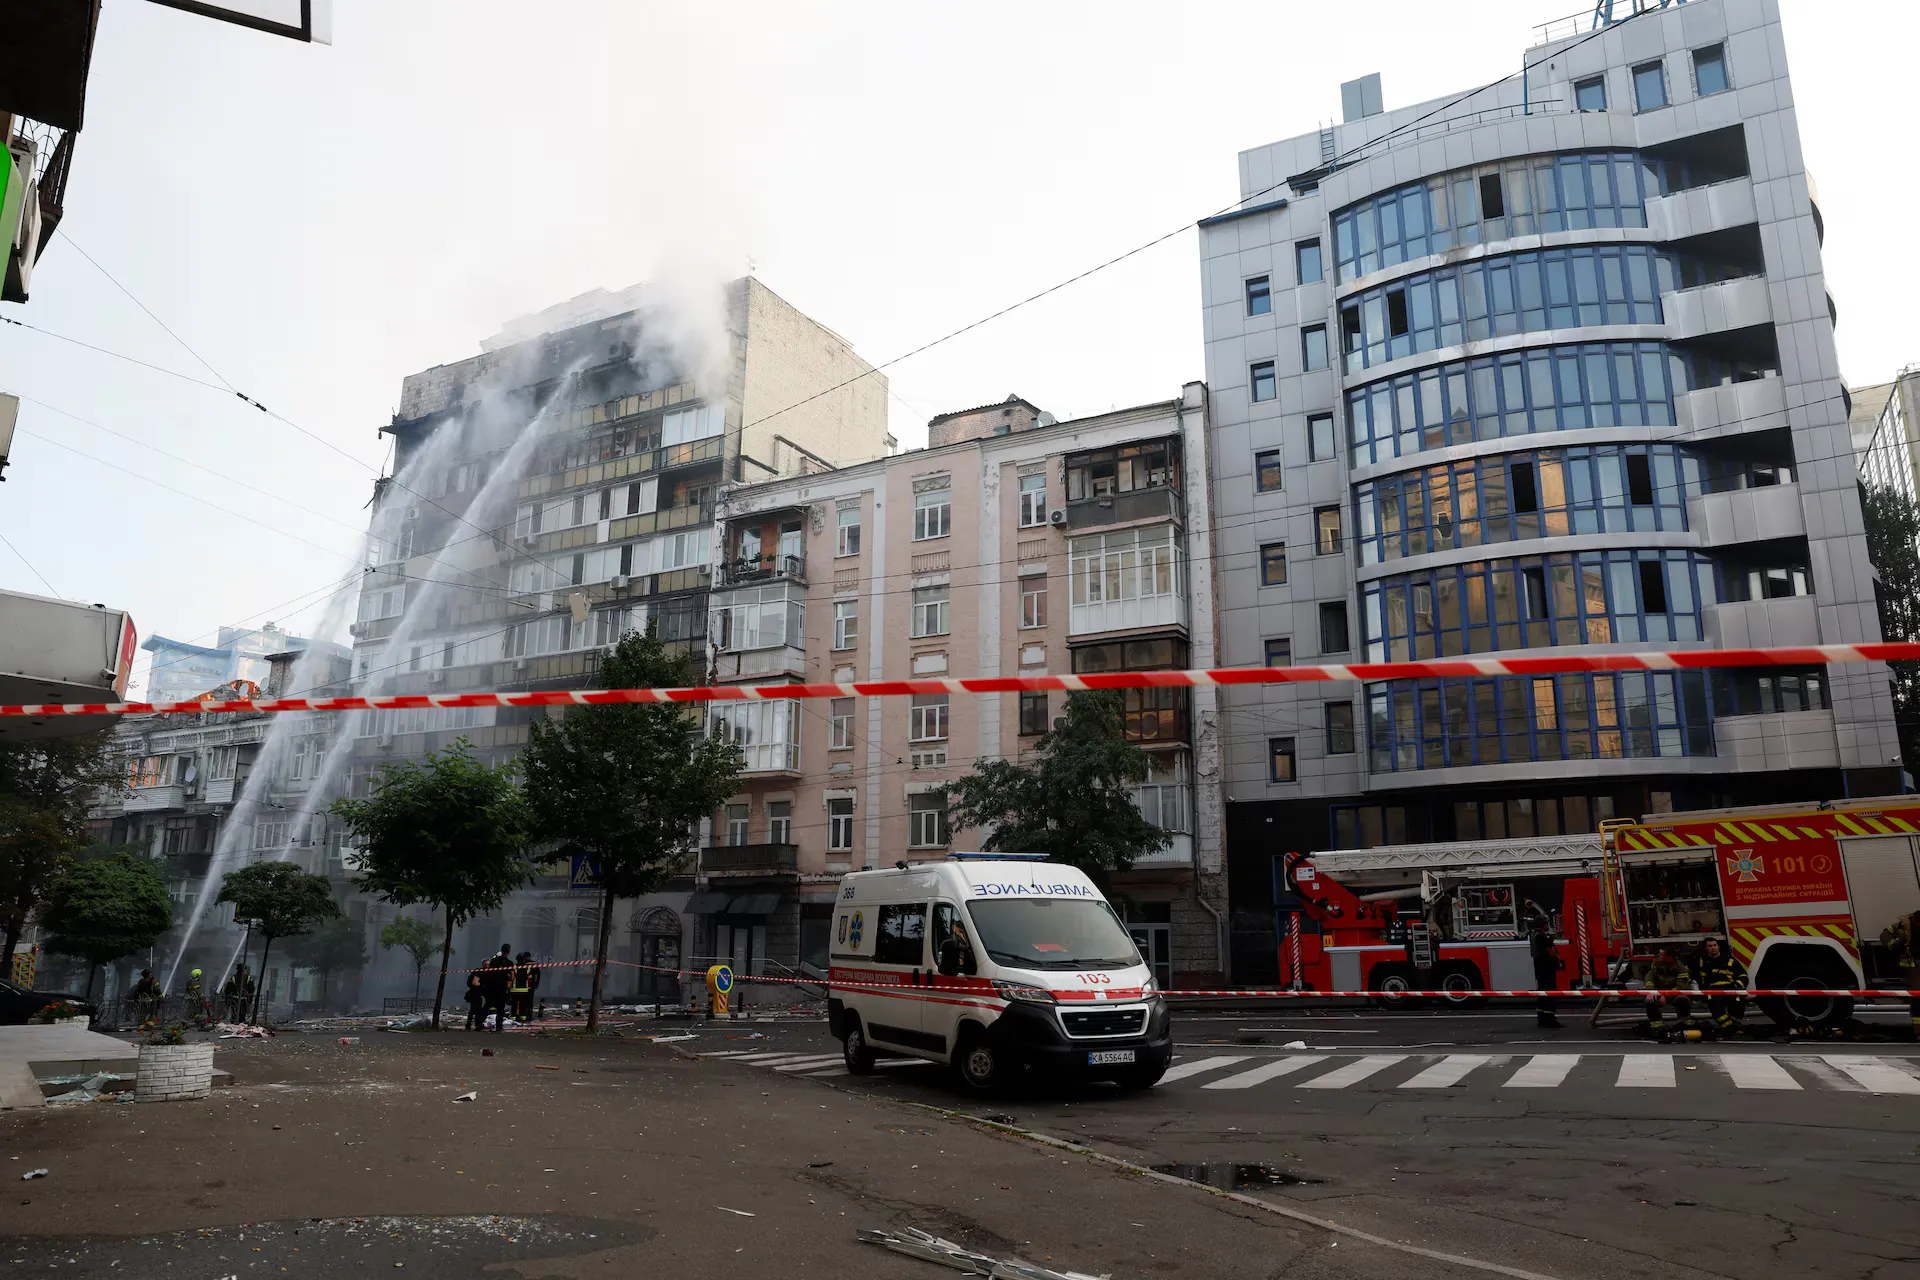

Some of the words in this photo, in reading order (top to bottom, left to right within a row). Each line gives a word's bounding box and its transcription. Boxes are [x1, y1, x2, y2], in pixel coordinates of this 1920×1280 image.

[1772, 856, 1806, 874] 101
[1772, 884, 1801, 892] СЛУЖБА
[1802, 882, 1833, 890] УКРАЇНИ
[843, 887, 855, 899] 368
[1743, 892, 1797, 900] НАДЗВИЧАЙНИХ
[1799, 888, 1834, 897] СИТУАЦІЙ
[1076, 973, 1111, 984] 103
[1092, 1054, 1103, 1063] KA
[1104, 1053, 1122, 1062] 5564
